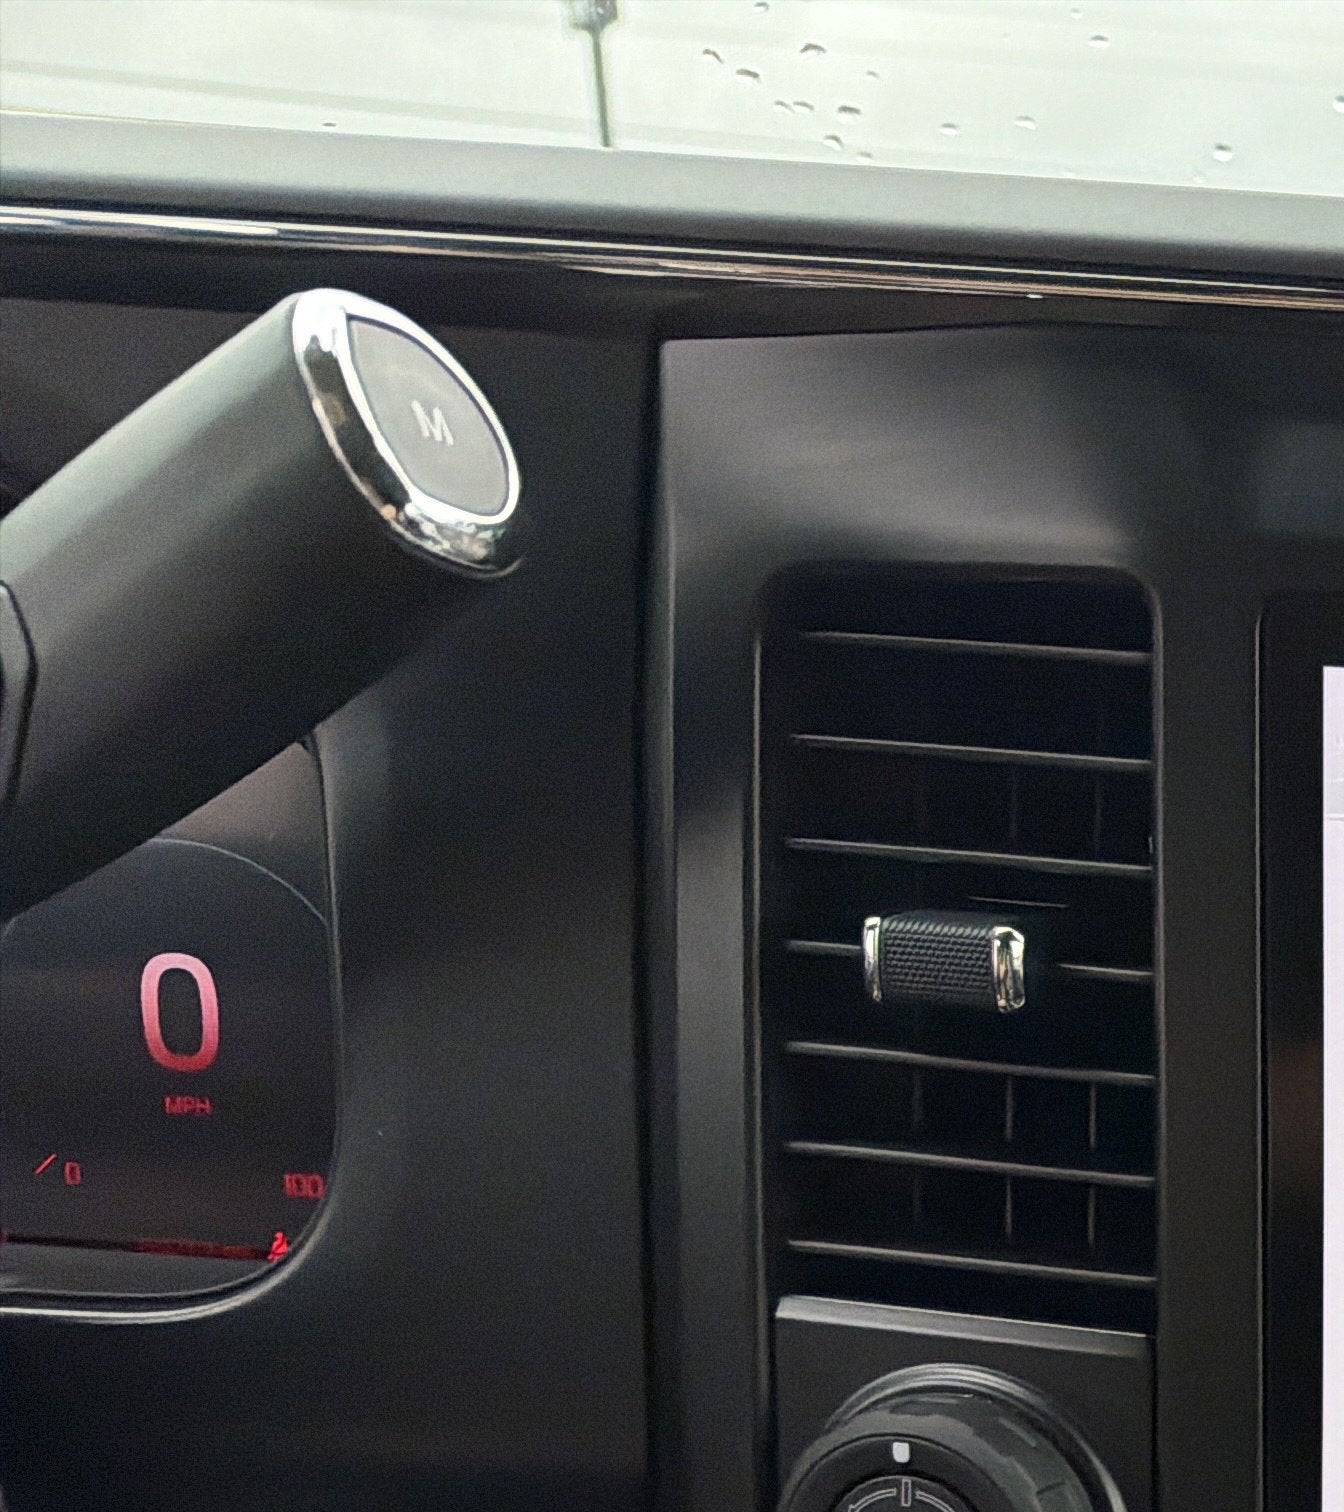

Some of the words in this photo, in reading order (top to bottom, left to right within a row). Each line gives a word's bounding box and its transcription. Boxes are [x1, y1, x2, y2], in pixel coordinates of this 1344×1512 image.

[140, 952, 219, 1072] 0
[163, 1095, 213, 1116] MPH
[64, 1161, 82, 1186] 0
[284, 1173, 326, 1200] 100
